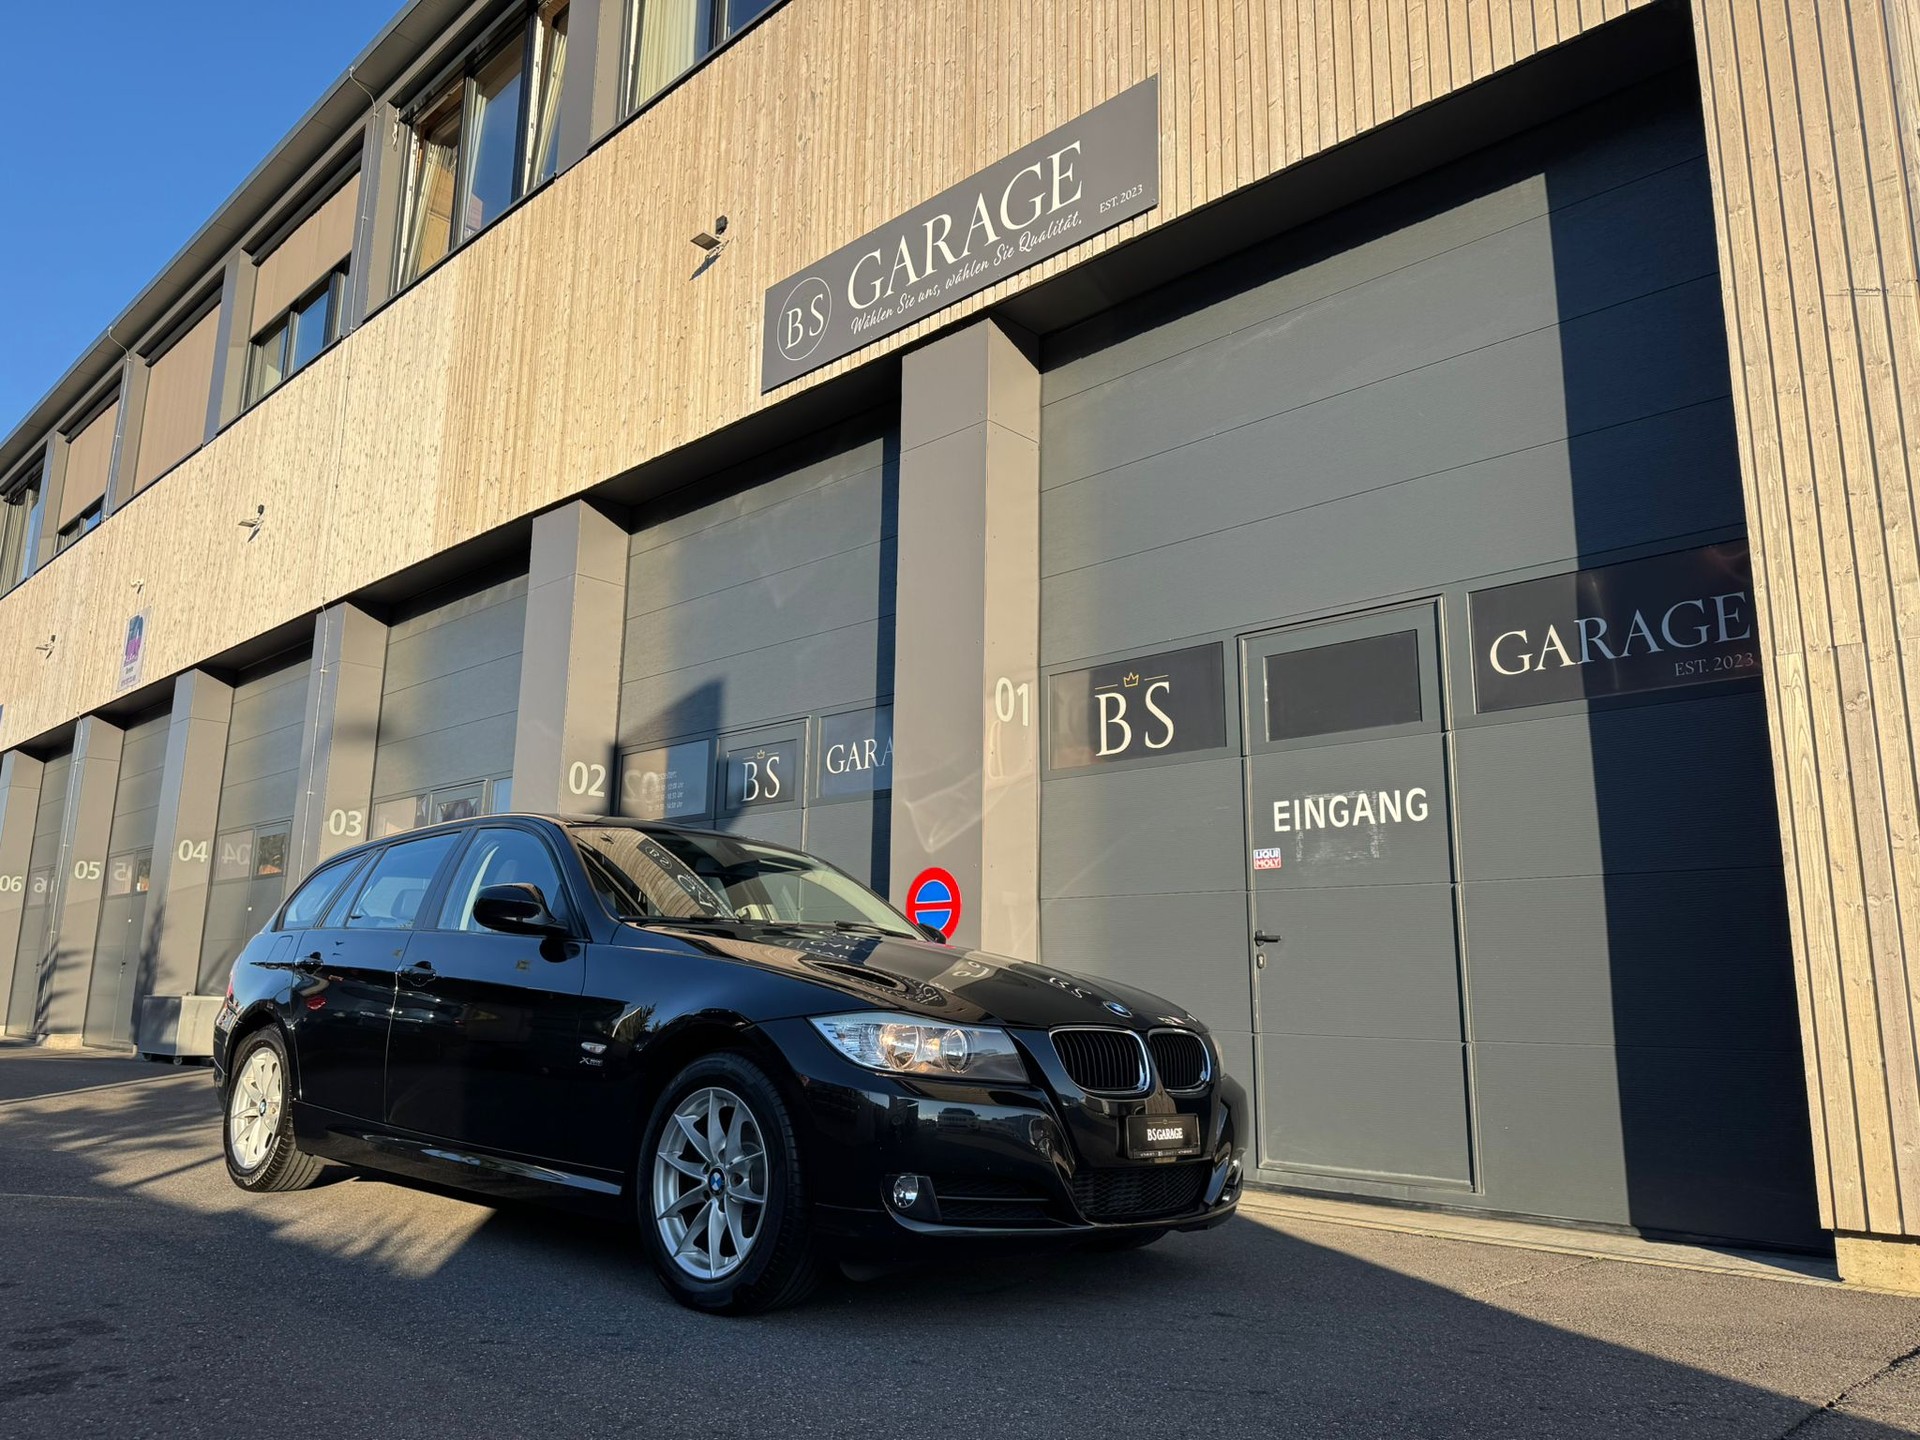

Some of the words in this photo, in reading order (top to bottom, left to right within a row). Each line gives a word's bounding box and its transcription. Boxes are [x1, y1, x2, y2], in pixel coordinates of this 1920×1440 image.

[1099, 196, 1119, 214] EST.
[1120, 184, 1143, 203] 2023
[847, 140, 1083, 310] GARAGE
[851, 307, 894, 335] Wählen
[897, 293, 916, 314] Sie
[918, 285, 941, 303] uns,
[945, 260, 989, 290] wählen
[993, 243, 1015, 267] Sie
[1018, 211, 1082, 253] Qualität.
[785, 293, 825, 350] BS
[1489, 591, 1751, 676] GARAGE
[1675, 658, 1709, 677] EST.
[1713, 652, 1754, 672] 2023
[995, 676, 1029, 727] 01
[1094, 681, 1175, 757] BS
[568, 761, 606, 798] 02
[742, 756, 780, 802] BS
[328, 809, 362, 837] 03
[1273, 787, 1429, 832] EINGANG
[74, 860, 101, 880] 05
[178, 839, 208, 863] 04
[1255, 859, 1280, 868] MOLY
[0, 875, 23, 893] 06
